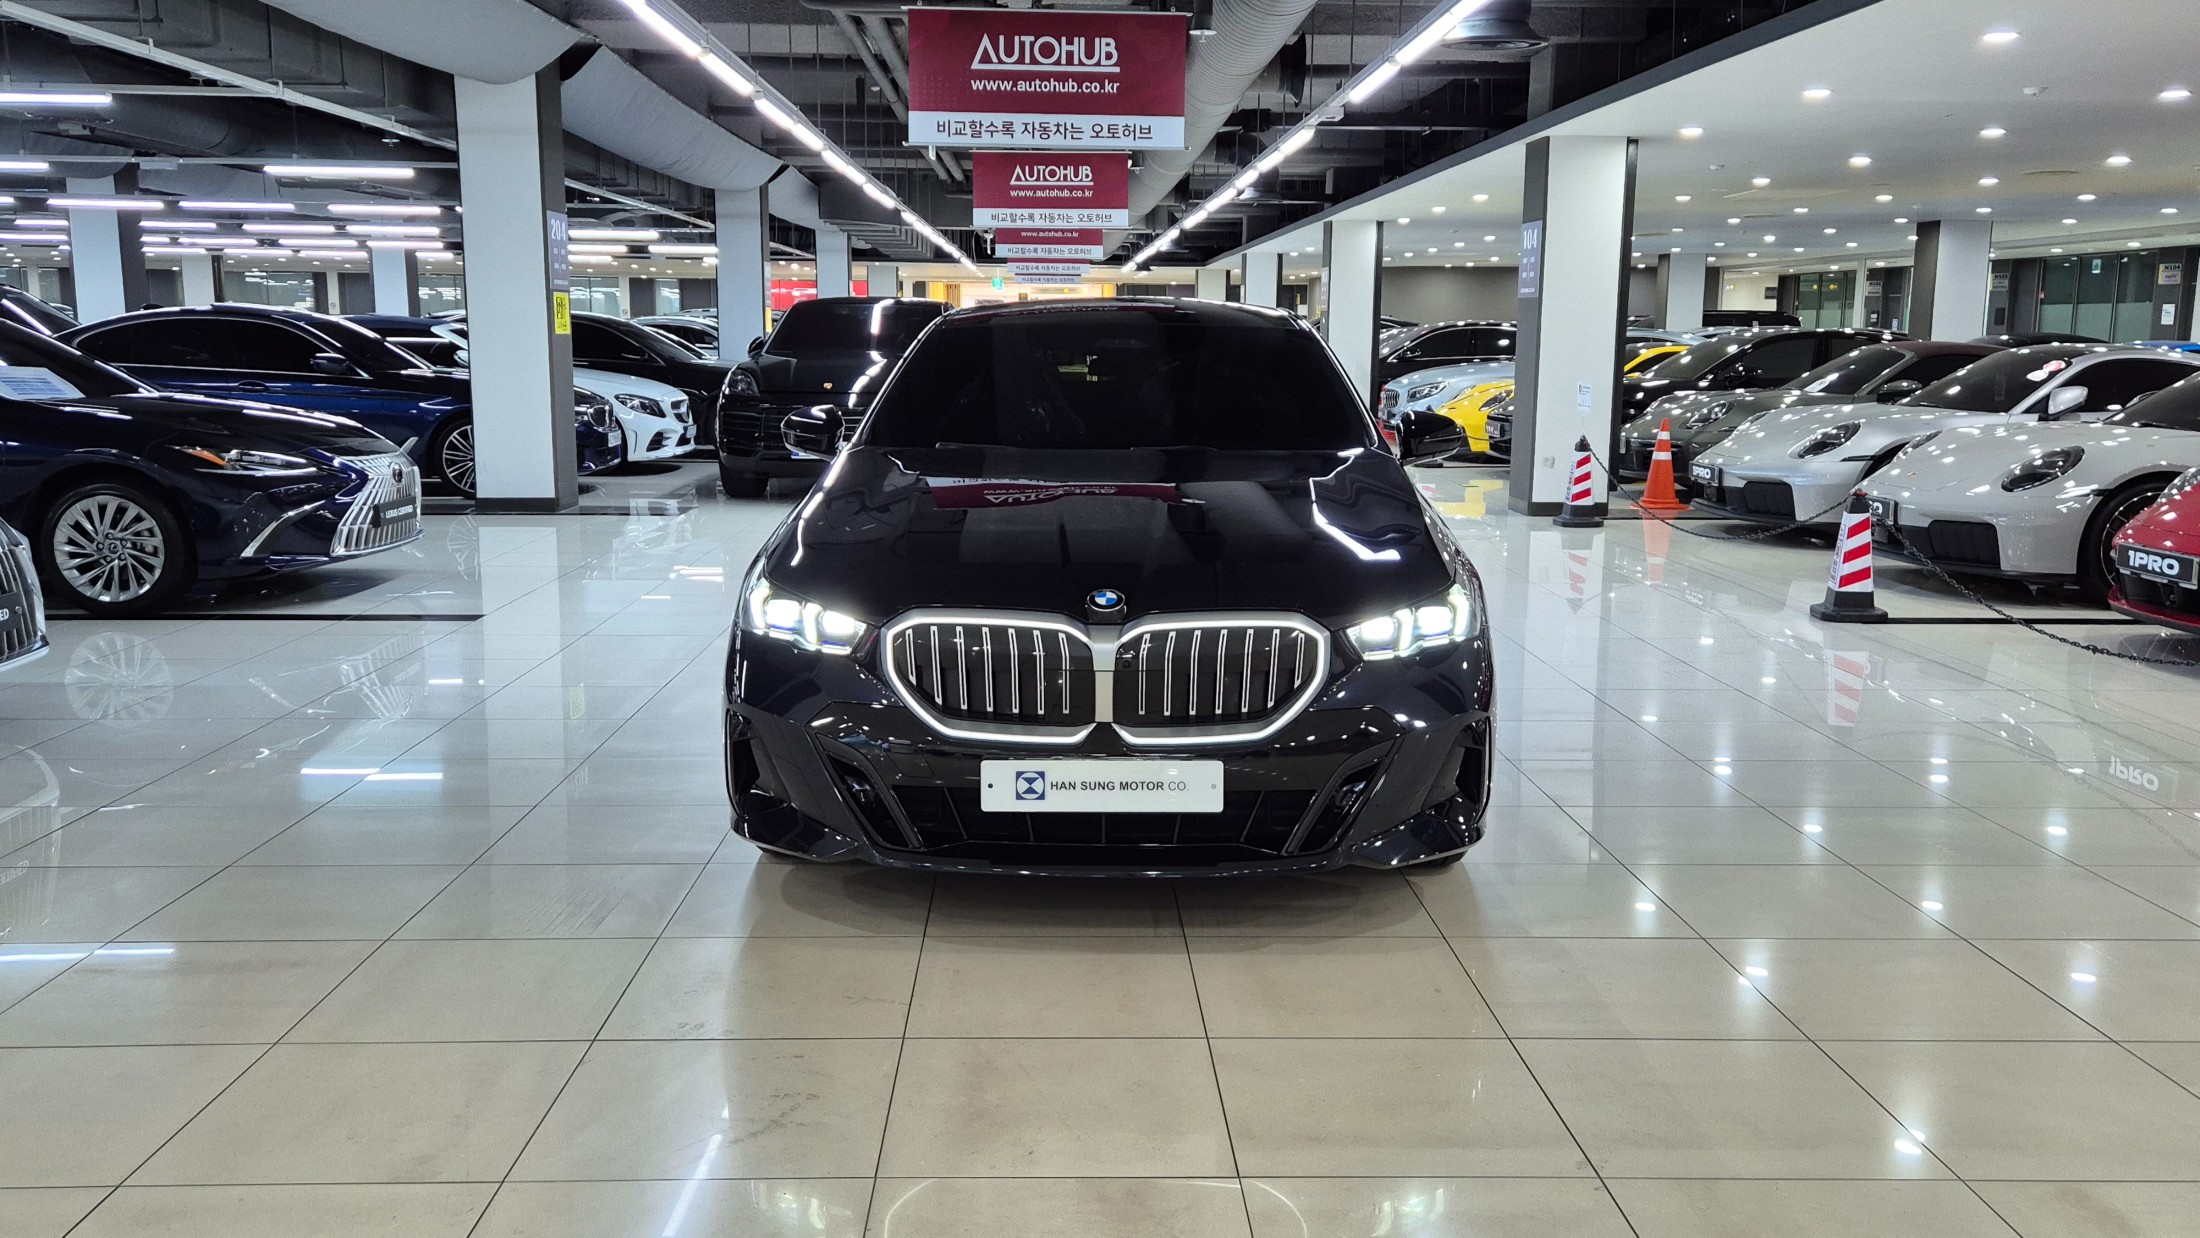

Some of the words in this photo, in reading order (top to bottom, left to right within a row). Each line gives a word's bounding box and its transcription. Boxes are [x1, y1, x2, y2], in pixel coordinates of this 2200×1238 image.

[971, 33, 1120, 72] AUTOHUB
[971, 78, 1120, 94] www.autohub.co.kr
[936, 120, 1016, 139] 비교할수록
[1021, 122, 1085, 140] 자동차는
[1089, 123, 1153, 141] 오토허브
[1010, 164, 1094, 185] AUTOHUB
[1010, 188, 1094, 198] www.autohub.co.kr
[991, 212, 1035, 223] 비교할수록
[1039, 213, 1074, 223] 자동차는
[1077, 213, 1112, 223] 오토허브
[550, 218, 566, 241] 204
[1523, 228, 1538, 249] 104
[1040, 247, 1066, 255] 자동차는
[2127, 549, 2180, 576] 1PRO
[1050, 780, 1077, 791] HAN
[1080, 780, 1116, 791] SUNG
[1119, 780, 1164, 791] MOTOR
[1168, 781, 1190, 792] CO.
